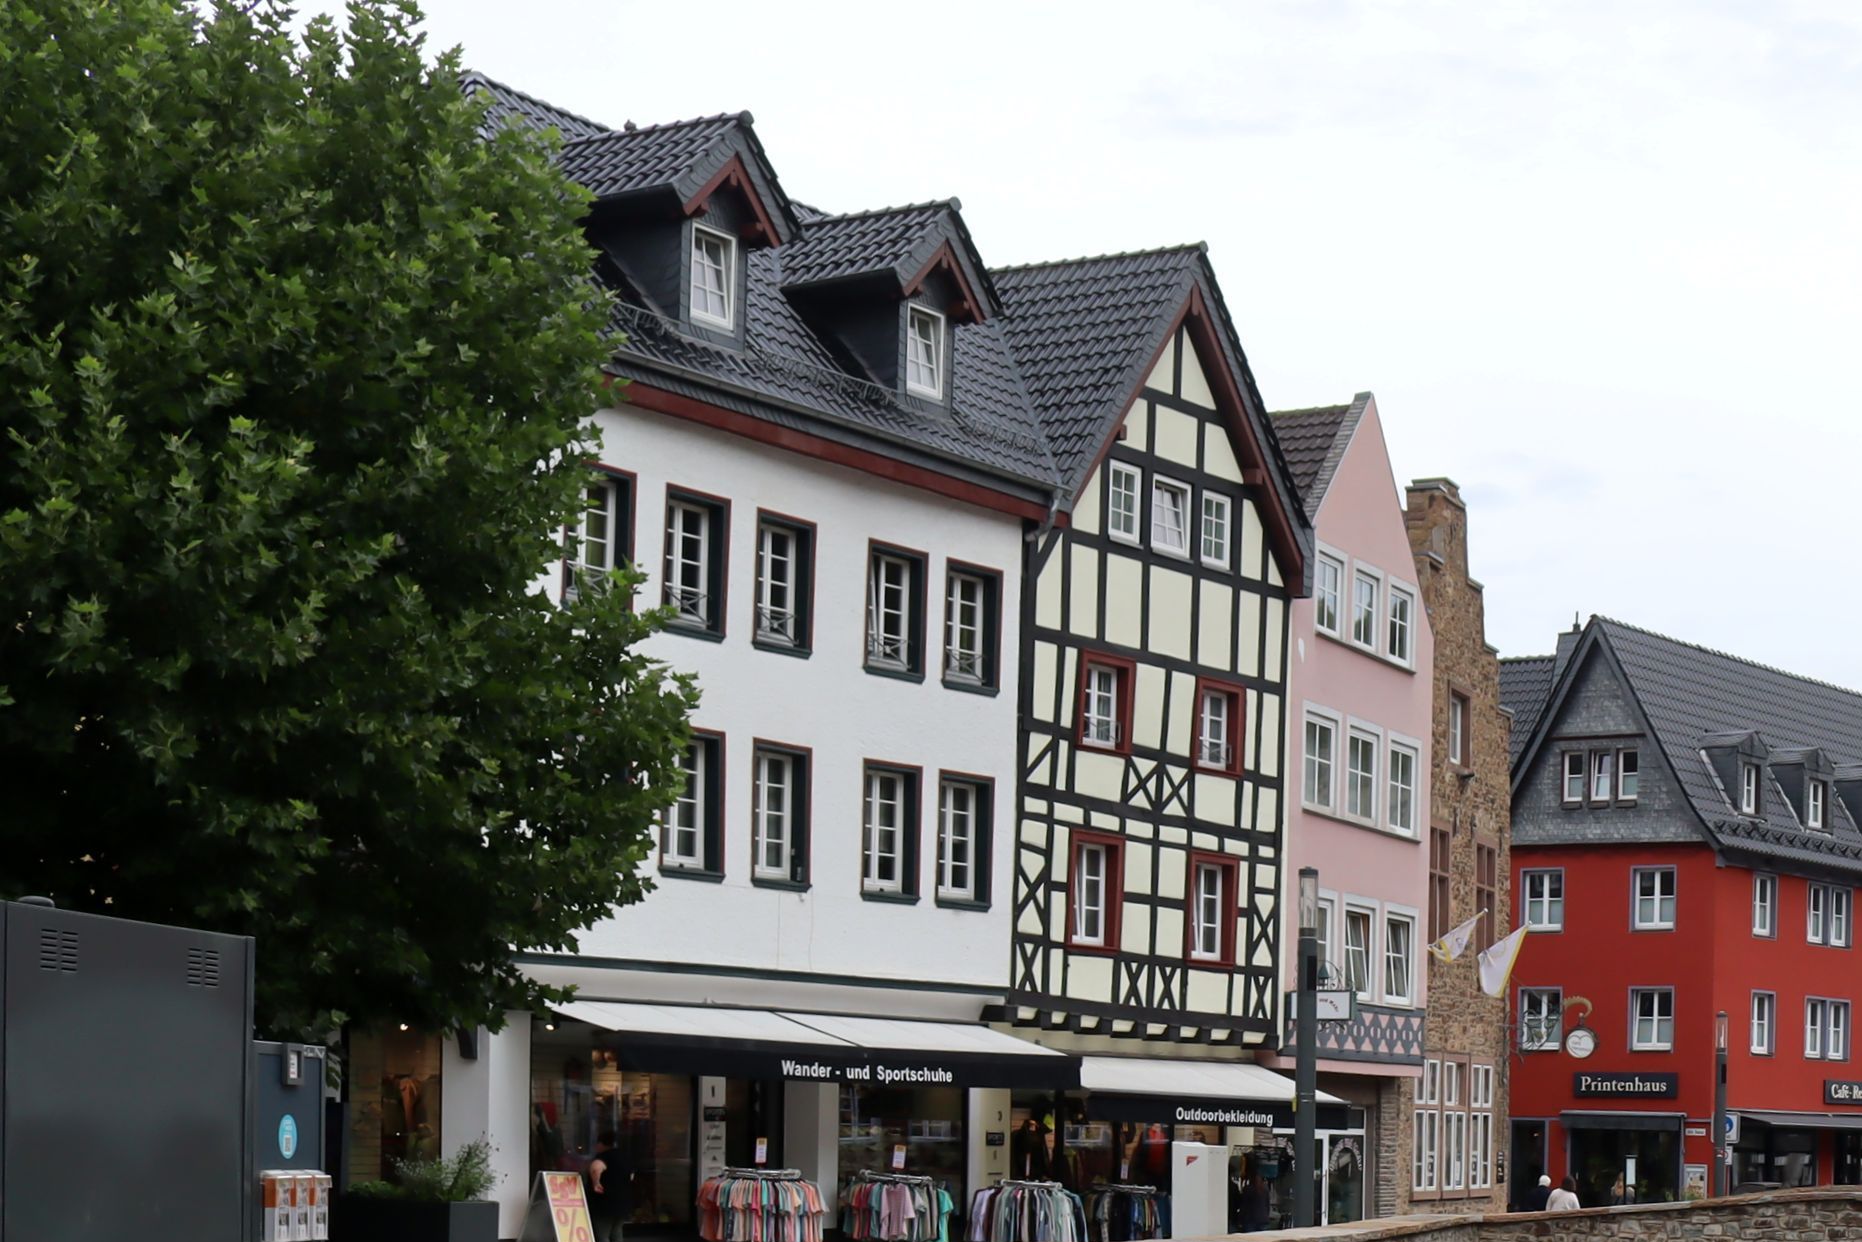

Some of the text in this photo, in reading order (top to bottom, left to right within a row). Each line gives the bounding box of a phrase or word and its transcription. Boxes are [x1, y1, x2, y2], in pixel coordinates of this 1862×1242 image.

[781, 1060, 832, 1078] Wander
[846, 1065, 870, 1080] und
[876, 1065, 953, 1084] Sportschuhe
[1580, 1076, 1667, 1092] Printenhaus
[1176, 1107, 1273, 1127] Outdoorbekleidung
